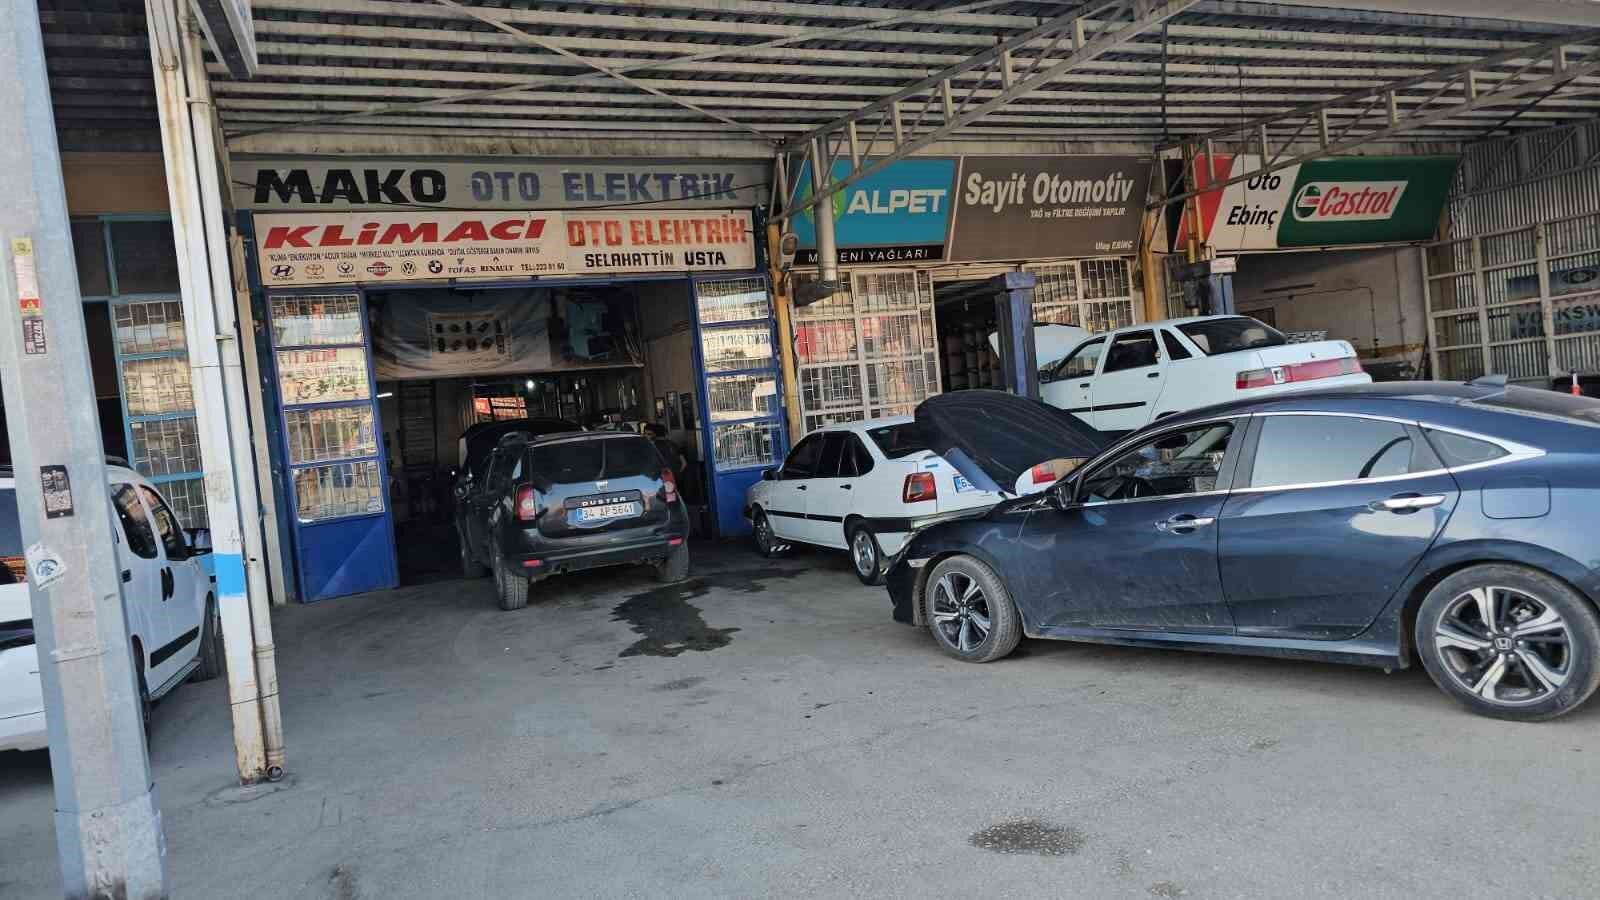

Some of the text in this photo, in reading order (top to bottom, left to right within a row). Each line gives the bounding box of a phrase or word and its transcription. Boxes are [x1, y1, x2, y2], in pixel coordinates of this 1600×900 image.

[254, 169, 447, 204] MAKO
[471, 171, 541, 202] OTO
[965, 172, 1135, 213] Sayit Otomotiv
[847, 189, 947, 214] ALPET
[1318, 186, 1398, 217] Castrol
[1227, 205, 1278, 231] Ebinç
[567, 220, 623, 247] OTO
[480, 264, 514, 272] RENAULT
[684, 251, 726, 266] USTA
[869, 249, 928, 261] YAĞLARI
[581, 496, 627, 507] DUSTER
